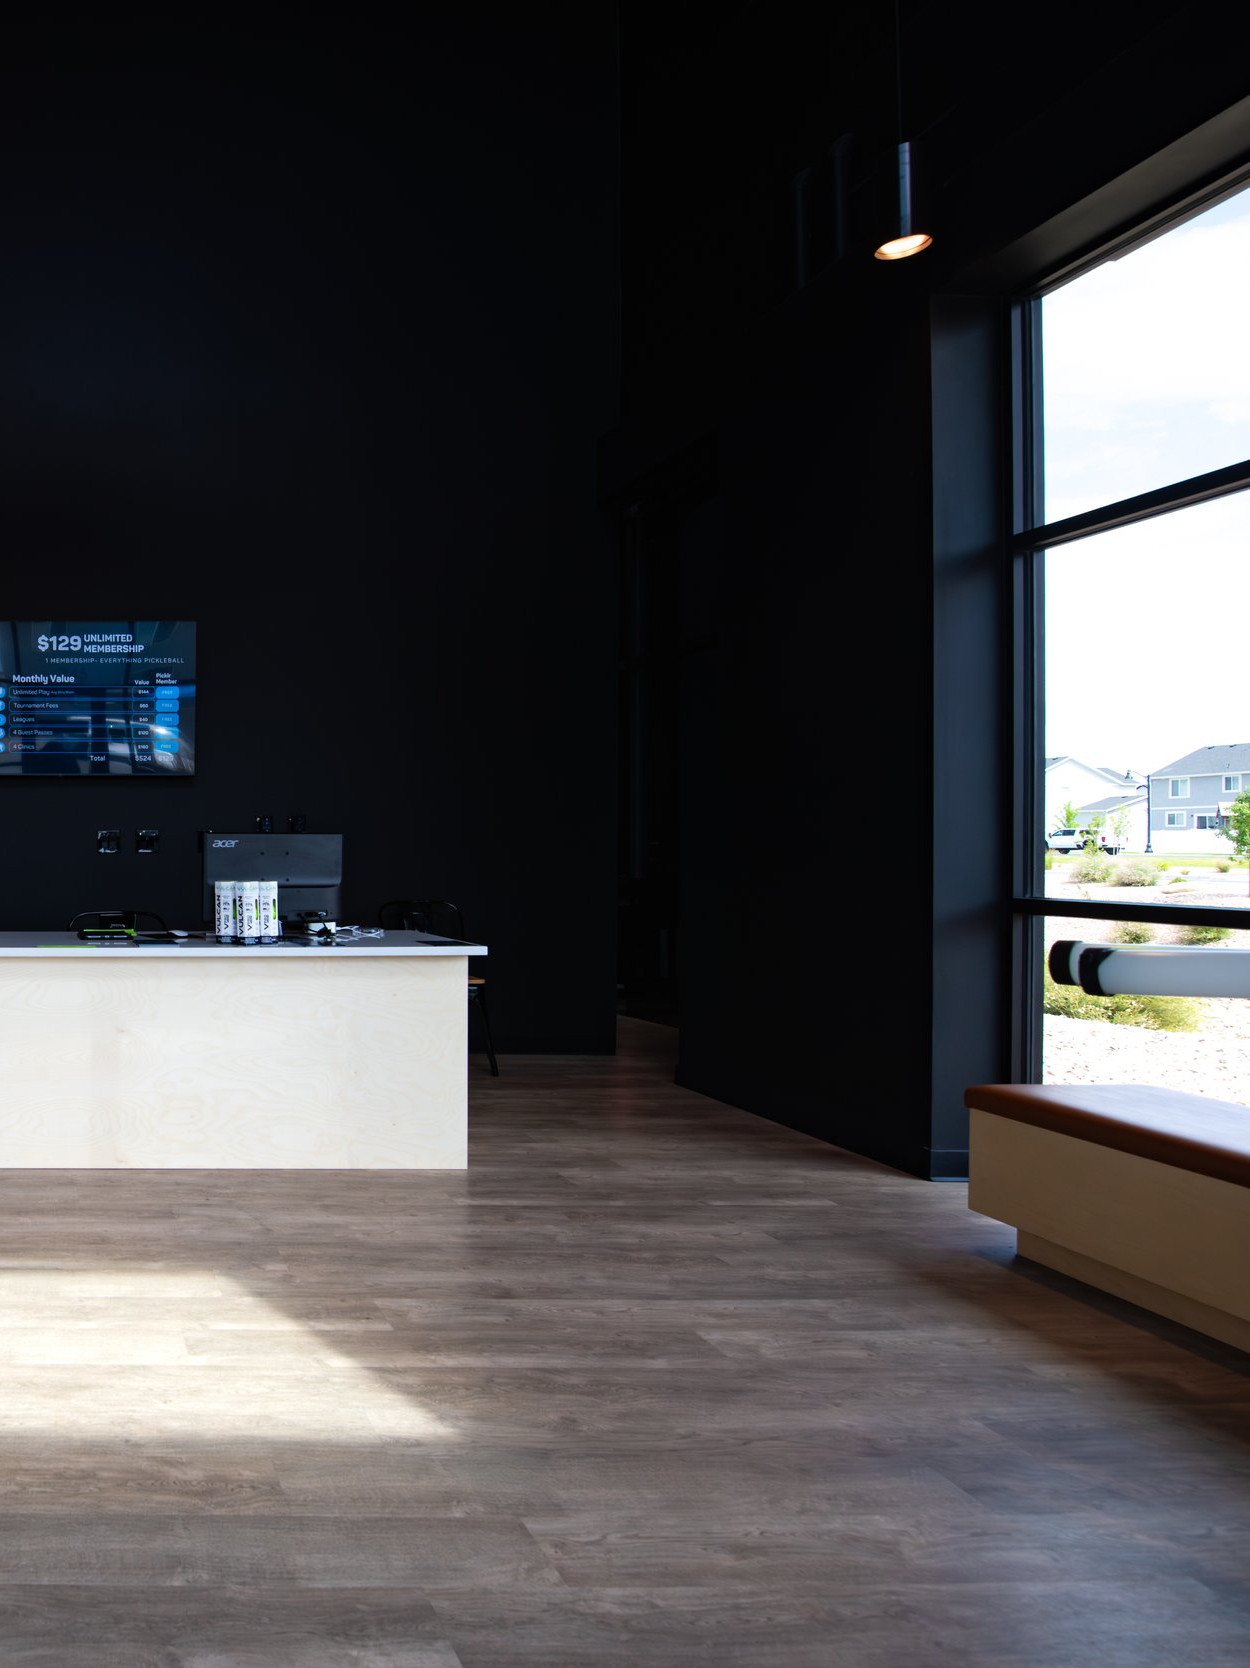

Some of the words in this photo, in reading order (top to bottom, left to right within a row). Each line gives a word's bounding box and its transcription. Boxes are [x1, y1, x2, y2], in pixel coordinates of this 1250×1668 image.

[37, 634, 82, 652] $129
[83, 634, 133, 643] UNLIMITED
[83, 644, 145, 653] MEMBERSHIP
[12, 674, 49, 685] Monthly
[49, 674, 75, 684] Value
[212, 839, 239, 848] acer
